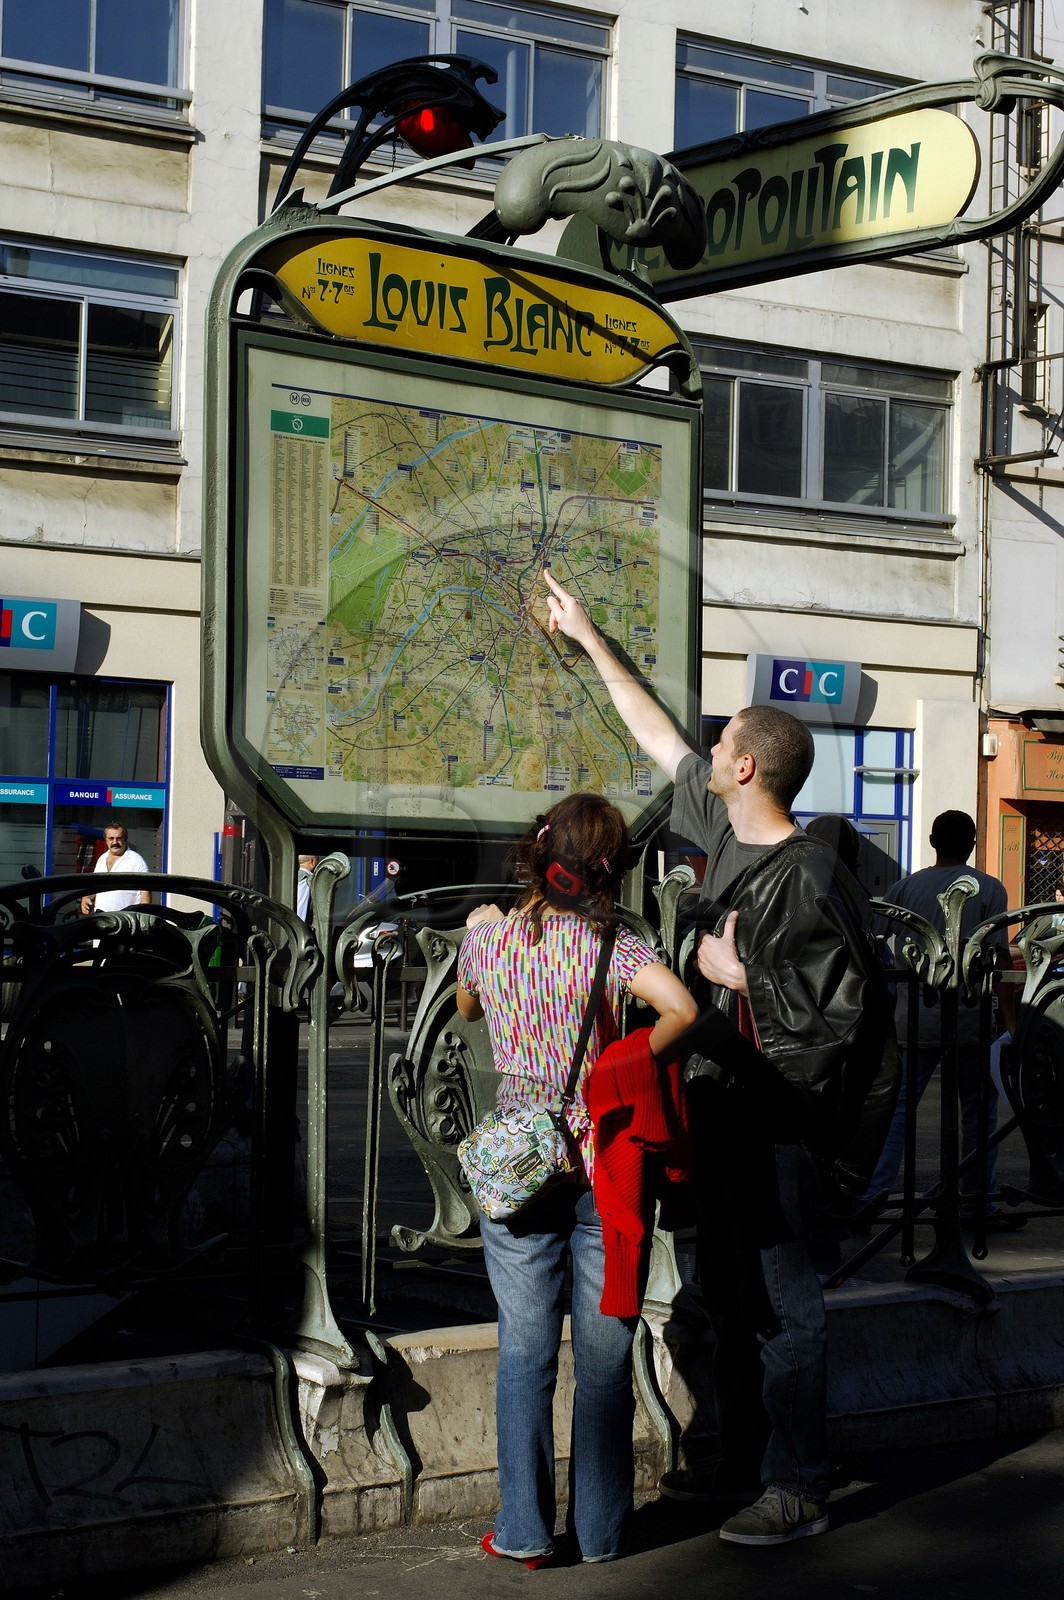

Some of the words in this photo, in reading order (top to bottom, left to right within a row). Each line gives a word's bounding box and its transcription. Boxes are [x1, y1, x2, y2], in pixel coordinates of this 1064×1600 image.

[315, 257, 356, 279] LIGNES
[362, 252, 469, 334] LOUIS
[483, 277, 596, 358] BLANC
[603, 313, 638, 333] LIGNES
[778, 668, 838, 697] CIC
[1047, 750, 1064, 764] Bij
[0, 788, 35, 796] SSURANCE
[69, 791, 99, 799] BANQUE
[114, 793, 153, 801] ASSURANCE
